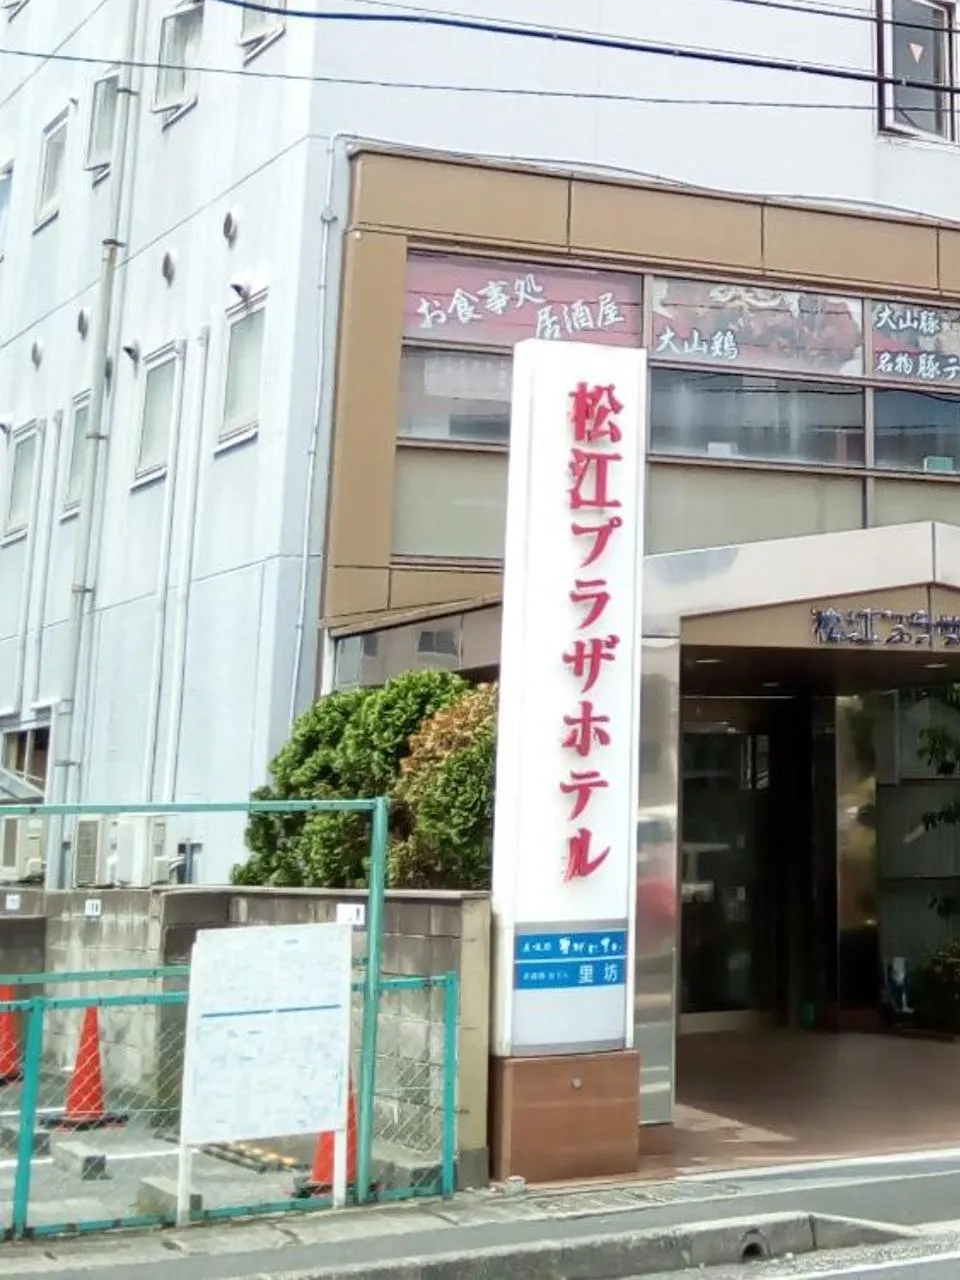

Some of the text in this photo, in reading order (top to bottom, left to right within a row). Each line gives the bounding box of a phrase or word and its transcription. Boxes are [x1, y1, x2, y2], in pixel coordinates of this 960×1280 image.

[416, 273, 546, 328] お食事処
[536, 292, 624, 339] 居酒屋
[656, 325, 738, 359] 大山鶏
[559, 382, 623, 883] 松江プラザホテル
